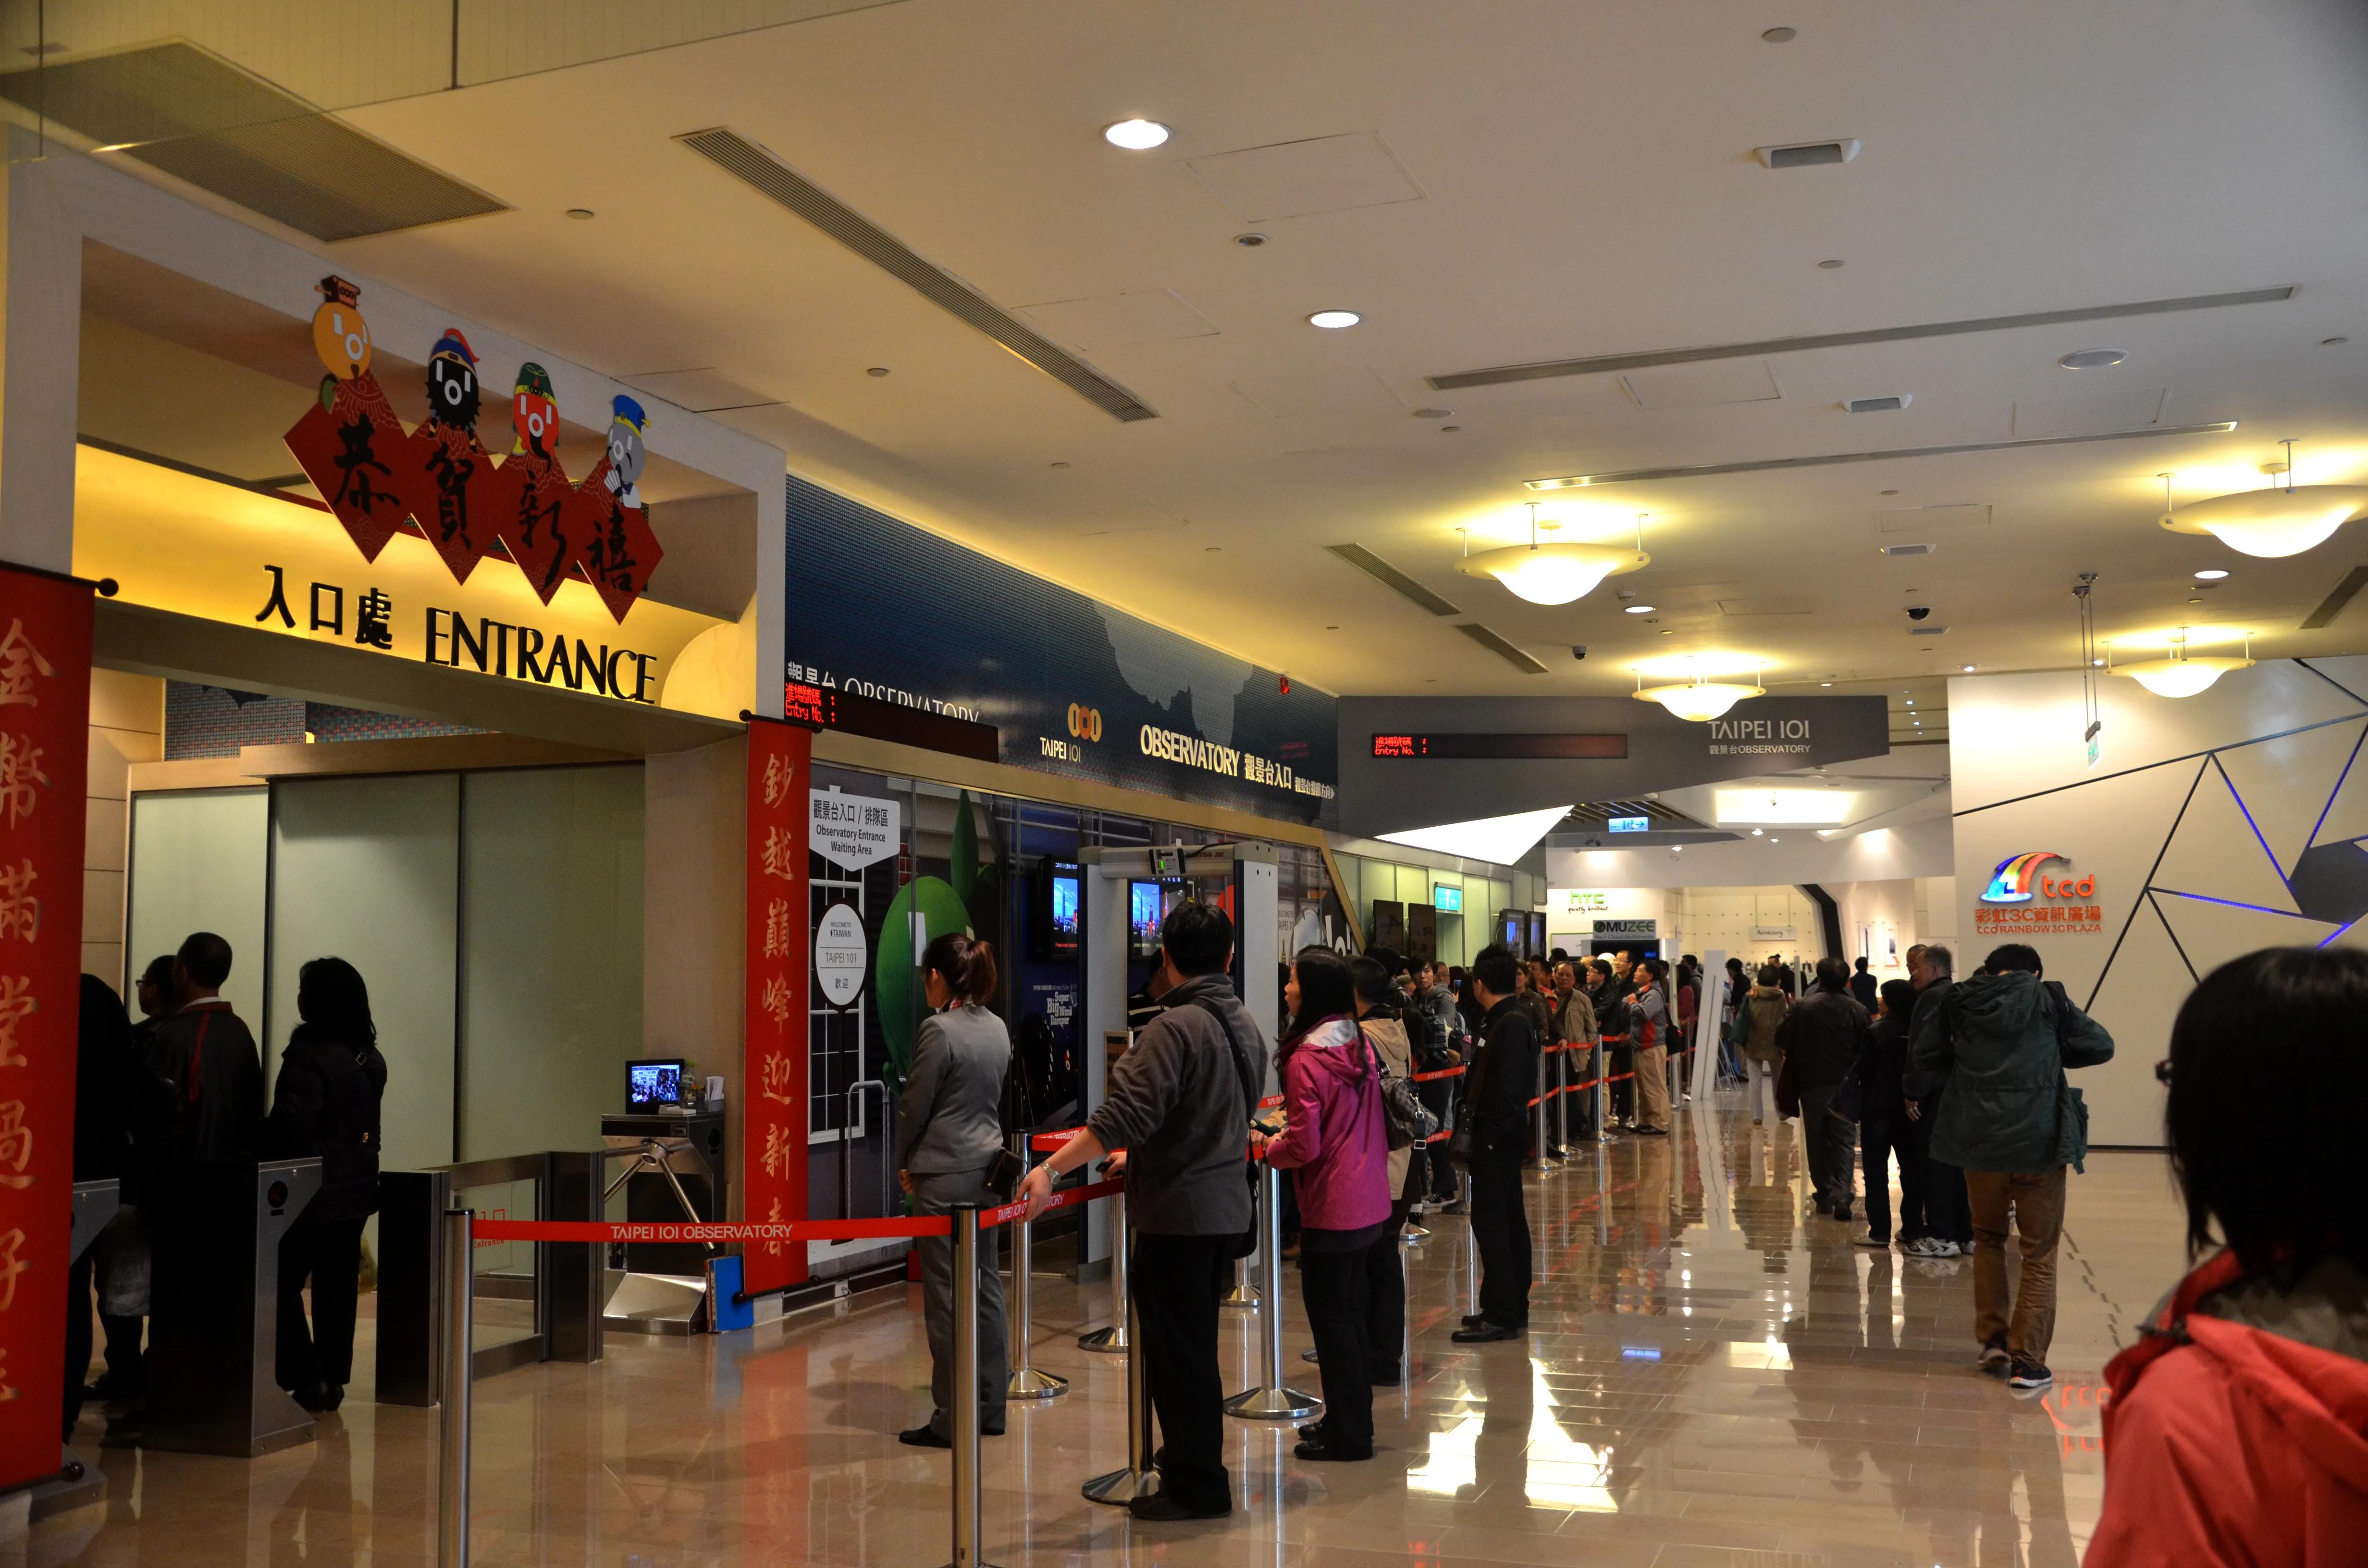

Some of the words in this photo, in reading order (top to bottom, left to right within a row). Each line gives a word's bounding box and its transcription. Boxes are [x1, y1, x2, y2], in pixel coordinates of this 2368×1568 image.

[255, 564, 393, 650] 入口處
[425, 607, 657, 704] ENTRANCE
[785, 683, 821, 706] 進場號碼
[786, 699, 809, 720] Entry
[812, 708, 824, 723] No.
[1706, 720, 1772, 739] TAIPEI
[1040, 736, 1066, 760] TAIPEI
[1141, 724, 1240, 777] OBSERVATORY
[1245, 753, 1292, 789] 觀景台入口
[1375, 746, 1399, 756] Entry
[1402, 746, 1414, 756] No.
[814, 799, 855, 823] 觀景台入口
[865, 806, 888, 827] 排隊區
[816, 824, 857, 842] Observatory
[859, 829, 886, 842] Entrance
[831, 841, 856, 856] Waiting
[857, 844, 872, 855] Area
[2042, 874, 2095, 898] tcd
[1975, 906, 2101, 924] 彩虹3C資訊廣場
[833, 929, 851, 938] TAIWAN
[1976, 924, 1998, 933] tcd
[1999, 924, 2050, 933] RAINBOW
[2051, 924, 2065, 932] 3C
[2067, 924, 2101, 933] PLAZA
[826, 953, 844, 963] TAIPEI
[847, 953, 857, 963] 101
[1047, 998, 1059, 1017] Big
[998, 1206, 1013, 1221] TAIPEI
[611, 1225, 654, 1239] TAIPEI
[683, 1224, 793, 1239] OBSERVATORY
